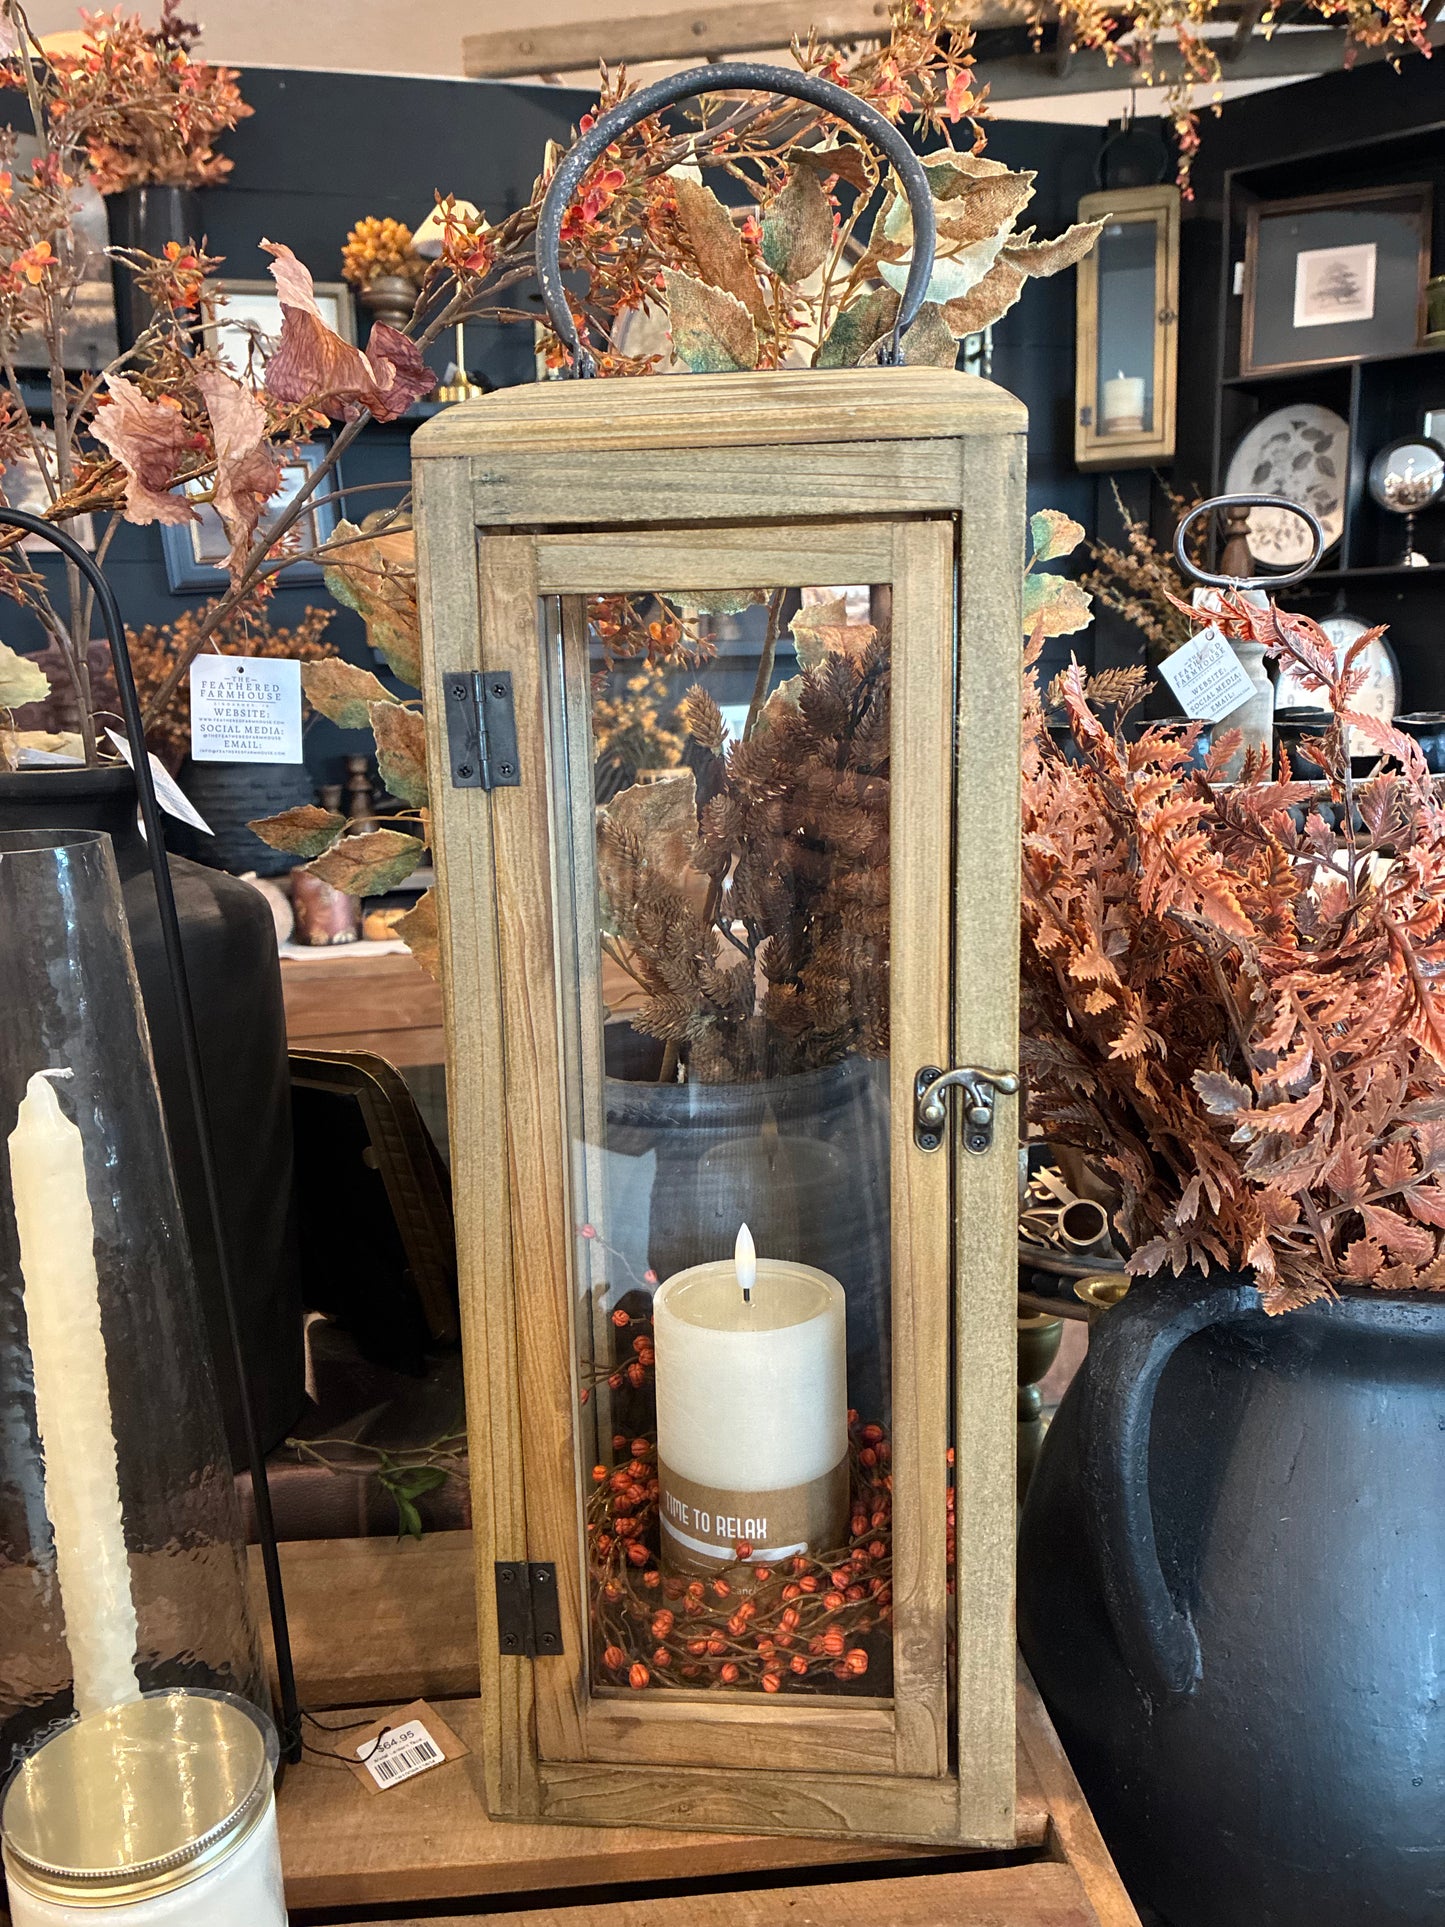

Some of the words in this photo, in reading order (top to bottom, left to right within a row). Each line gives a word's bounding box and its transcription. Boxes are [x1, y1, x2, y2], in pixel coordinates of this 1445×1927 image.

[1173, 642, 1221, 682] FEATHED
[1176, 647, 1225, 688] FARMHOUSE
[201, 681, 280, 692] FEATHERED
[1191, 667, 1227, 696] WEBSITE:
[1373, 671, 1382, 689] 2
[200, 689, 281, 701] FARMHOUSE
[1190, 691, 1216, 713] SOCIAL
[1216, 672, 1242, 695] MEDIA:
[1210, 691, 1235, 712] EMAIL:
[1375, 693, 1384, 711] 3
[214, 707, 270, 718] WEBSITE:
[200, 724, 241, 733] SOCIAL
[244, 726, 284, 735] MEDIA:
[224, 740, 262, 749] EMAIL:
[665, 1490, 690, 1526] TIME
[693, 1508, 710, 1533] TO
[716, 1515, 767, 1539] RELAX
[376, 1730, 415, 1753] $64.95
